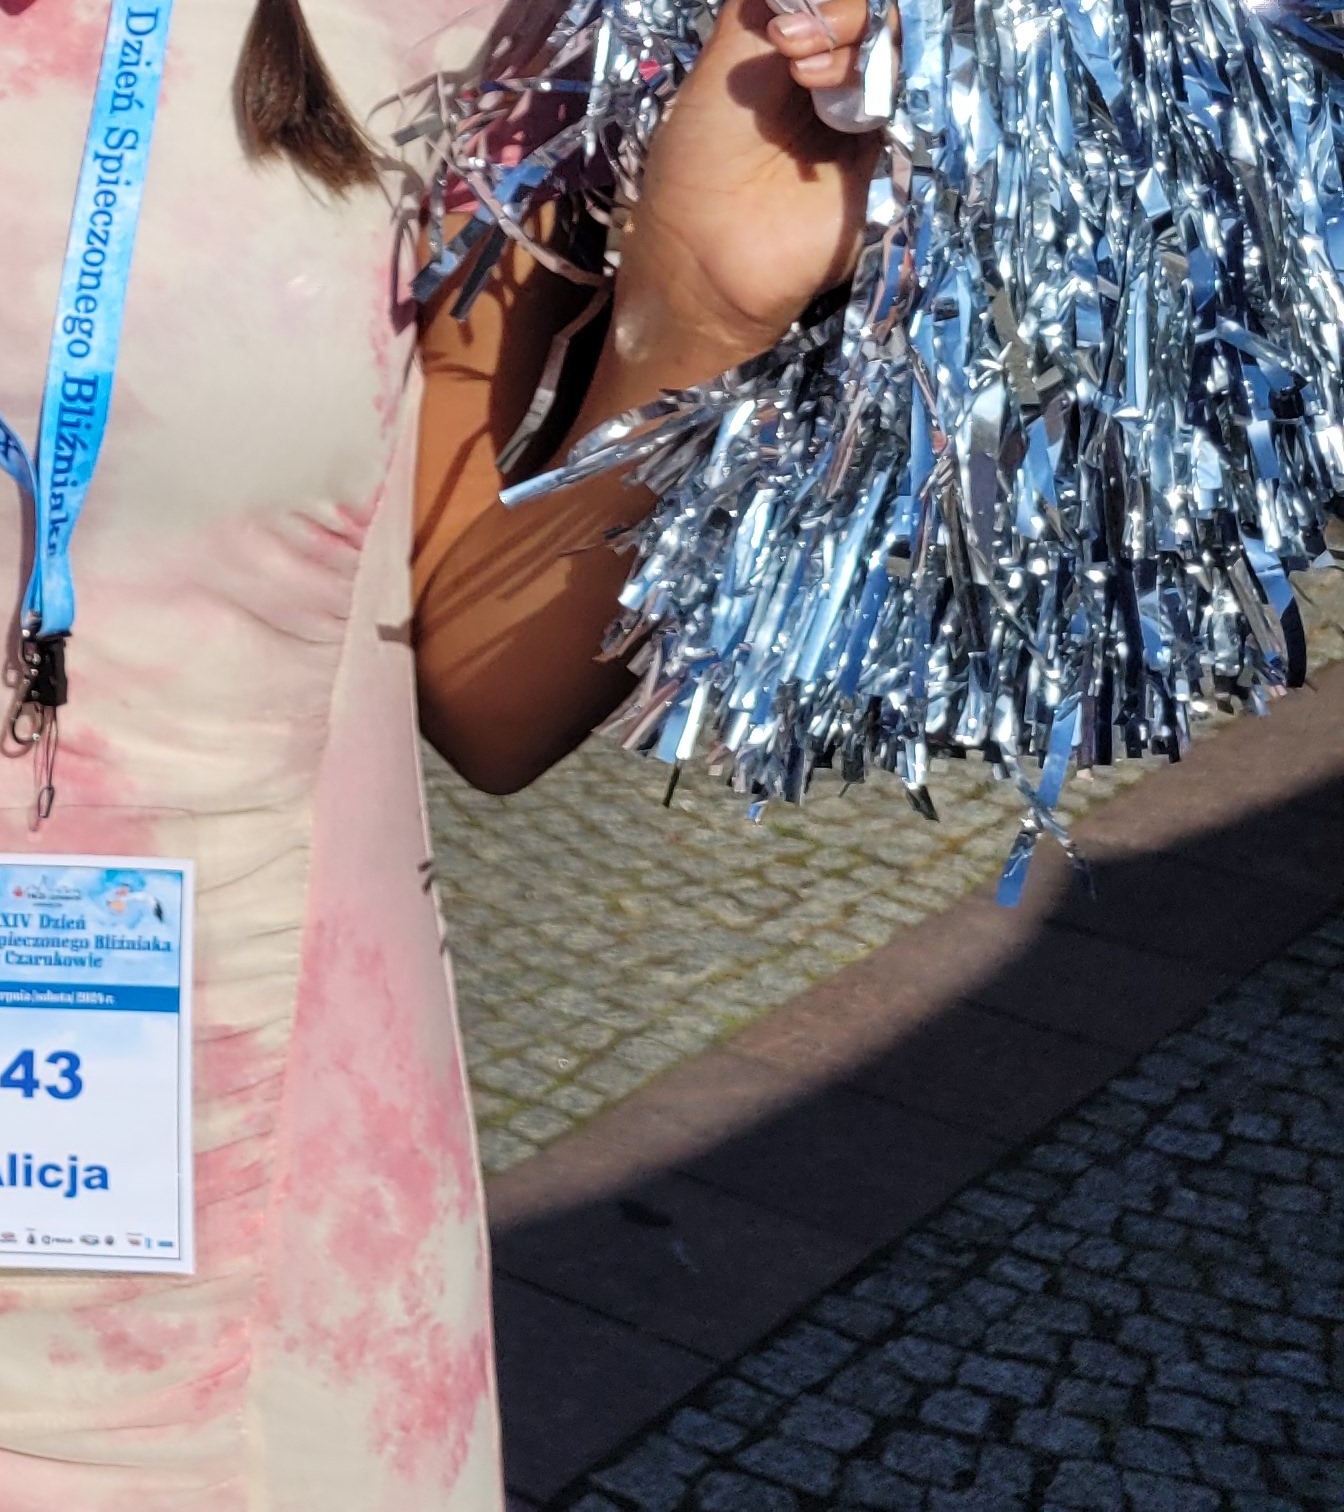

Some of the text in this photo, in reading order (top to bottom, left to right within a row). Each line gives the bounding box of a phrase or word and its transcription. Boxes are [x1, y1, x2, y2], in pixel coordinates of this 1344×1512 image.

[110, 7, 161, 115] Dzień
[63, 126, 141, 360] Spieczonego
[39, 912, 87, 930] Dzień
[94, 934, 173, 953] Bliźniaka
[5, 951, 104, 968] Czarnkowie
